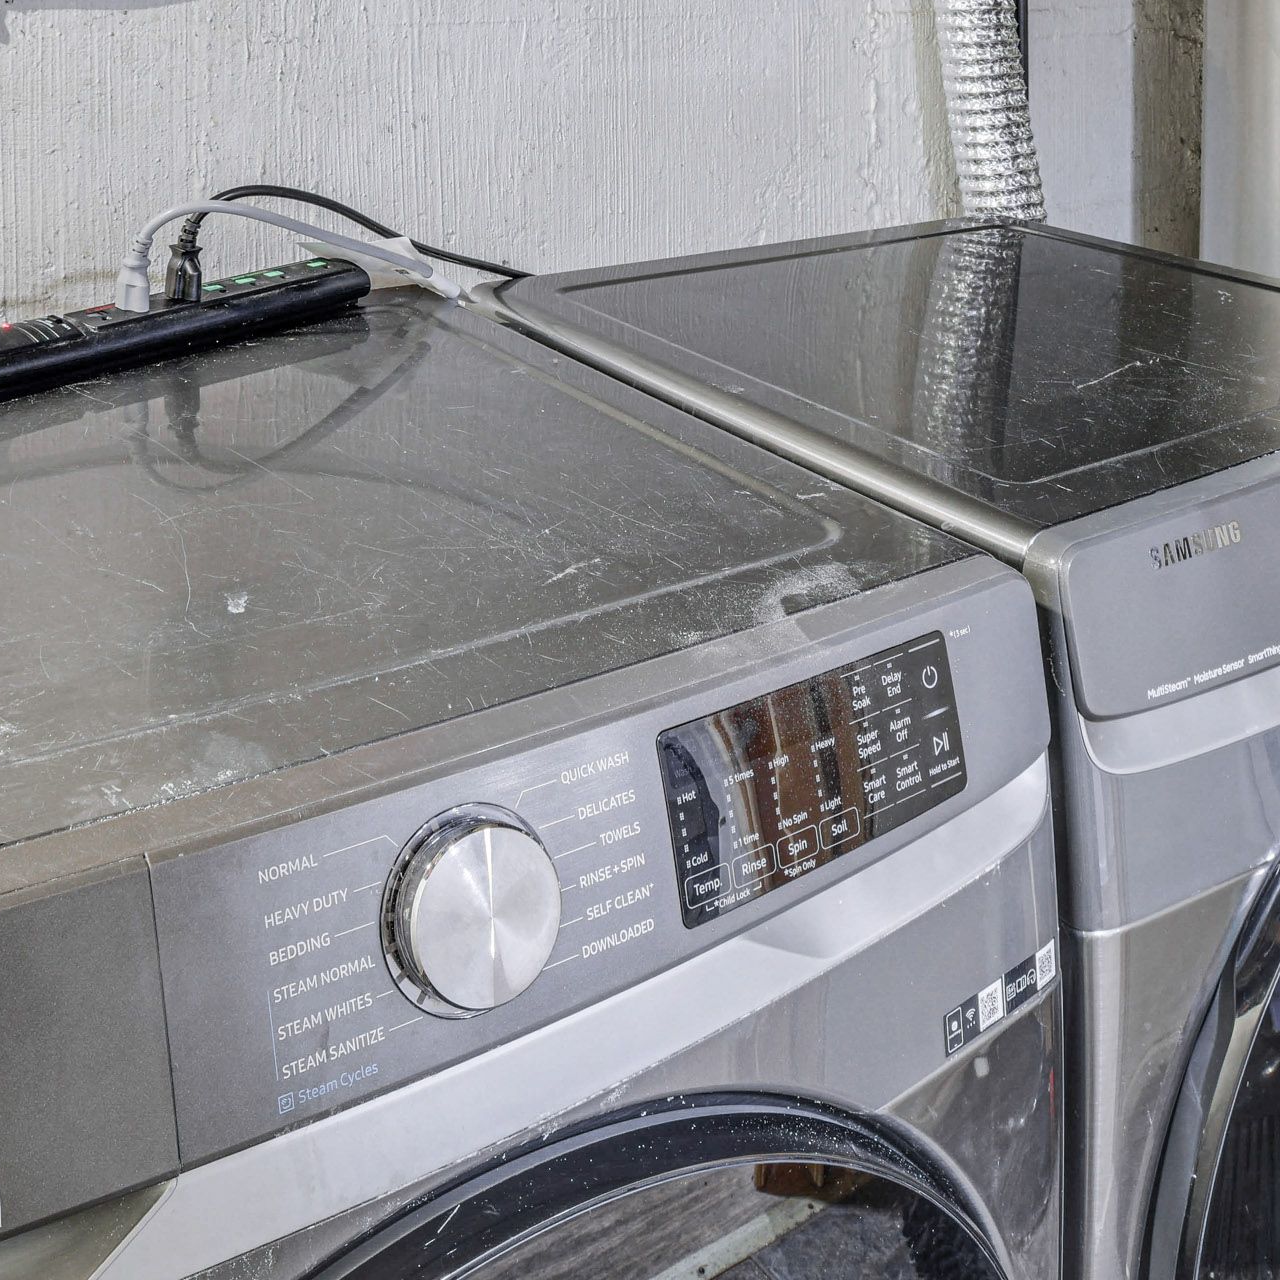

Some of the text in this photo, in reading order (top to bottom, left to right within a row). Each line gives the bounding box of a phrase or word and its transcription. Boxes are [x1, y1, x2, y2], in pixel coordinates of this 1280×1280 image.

[1148, 521, 1242, 570] SAMSUNG
[881, 671, 902, 686] Delay
[1193, 667, 1223, 685] Moisture
[1222, 658, 1245, 674] Sensor
[852, 685, 866, 697] Pre
[887, 684, 901, 697] End
[852, 696, 871, 711] Soak
[889, 716, 912, 732] Alarm
[814, 736, 836, 751] Heavy
[856, 729, 879, 746] Super
[896, 729, 908, 743] Off
[858, 741, 882, 760] Speed
[560, 751, 630, 784] QUICK WASH
[773, 754, 789, 768] High
[896, 760, 919, 778] Smart
[928, 764, 942, 777] Hold
[947, 755, 961, 769] Start
[728, 769, 755, 785] 5 times
[863, 774, 887, 793] Smart
[896, 773, 922, 792] Control
[577, 789, 636, 820] DELICATES
[681, 790, 696, 803] Hot
[824, 797, 842, 812] Light
[868, 790, 886, 804] Care
[782, 811, 808, 828] No Spin
[831, 820, 848, 836] Soil
[599, 821, 641, 846] TOWELS
[743, 832, 760, 847] time
[788, 839, 808, 856] Spin
[258, 853, 319, 884] NORMAL
[691, 852, 709, 868] Cold
[741, 857, 767, 876] Rinse
[801, 858, 817, 873] Only
[693, 877, 723, 896] Temp.
[735, 888, 751, 901] Lock
[264, 887, 349, 929] HEAVY DUTY
[586, 899, 613, 921] SELF
[581, 917, 655, 959] DOWNLOADED
[269, 931, 332, 966] BEDDING
[273, 954, 376, 1004] STEAM NORMAL
[277, 992, 374, 1041] STEAM WHITES
[282, 1026, 387, 1080] STEAM SANITIZE
[298, 1061, 379, 1104] Steam Cycles
